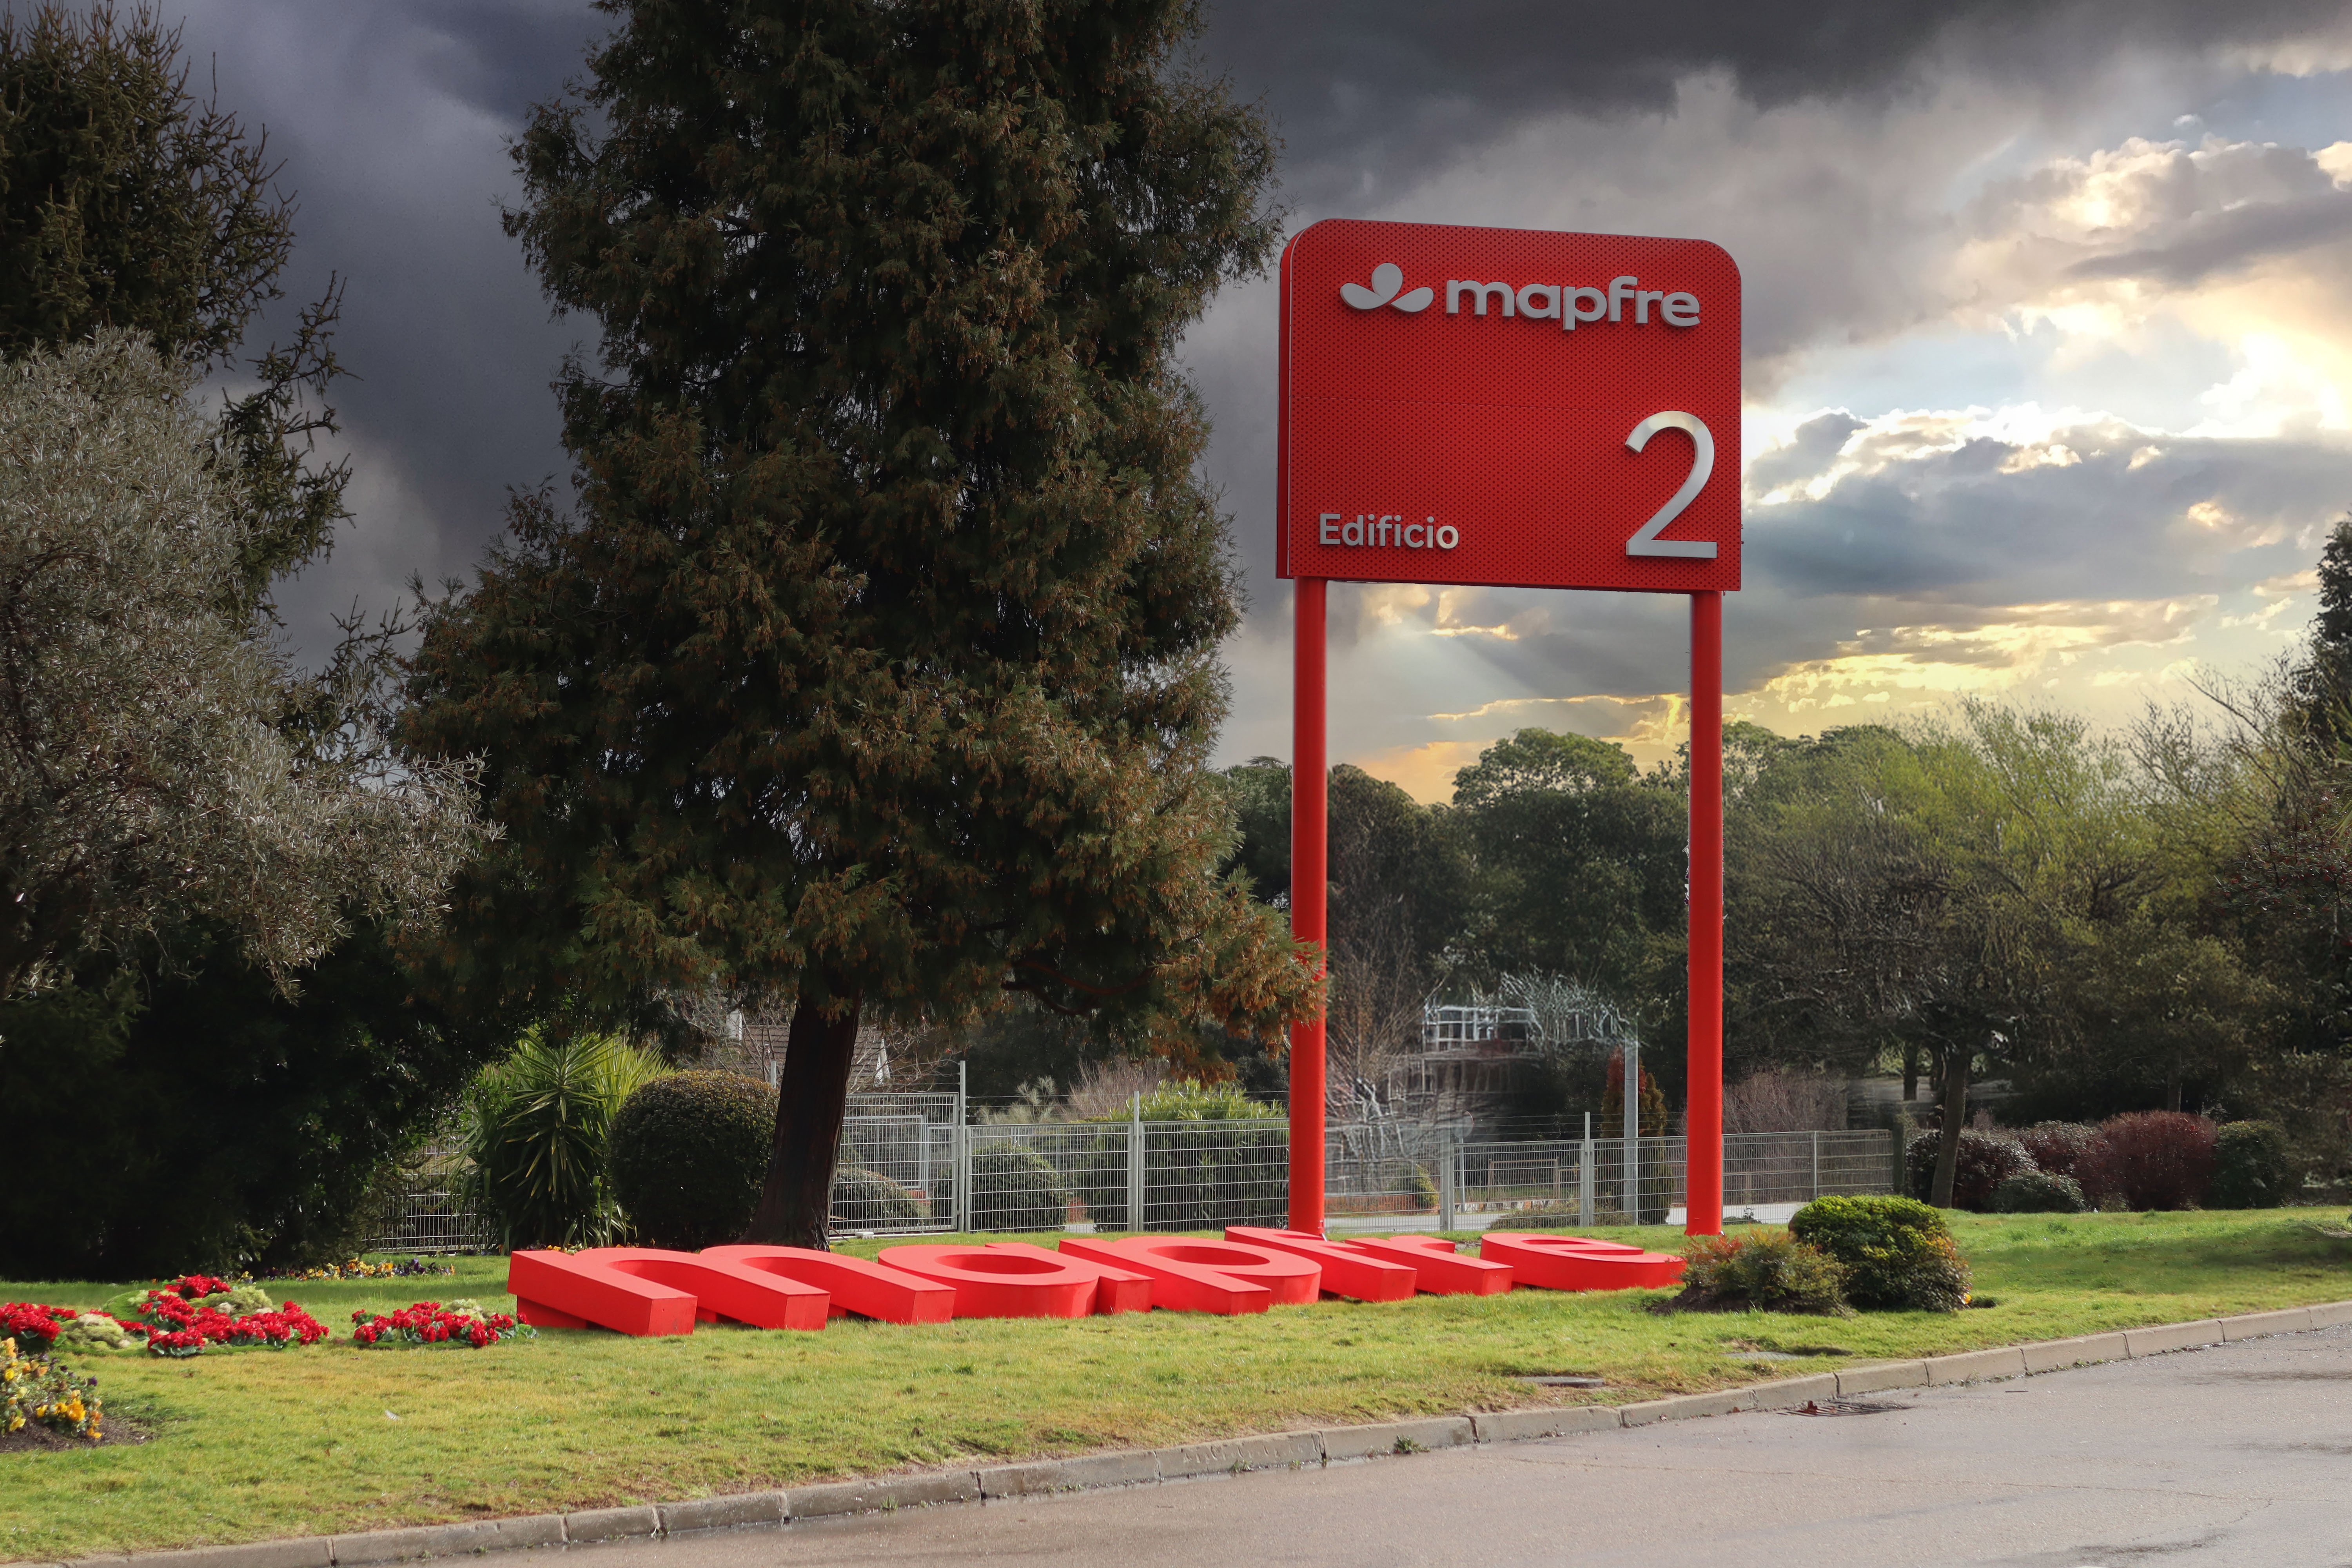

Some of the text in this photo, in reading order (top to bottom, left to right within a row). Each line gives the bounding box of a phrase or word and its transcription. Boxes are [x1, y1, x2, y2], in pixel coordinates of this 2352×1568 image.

[1446, 275, 1700, 330] mapfre
[1318, 410, 1718, 559] Edificio 2
[507, 1225, 1686, 1337] mapfre
